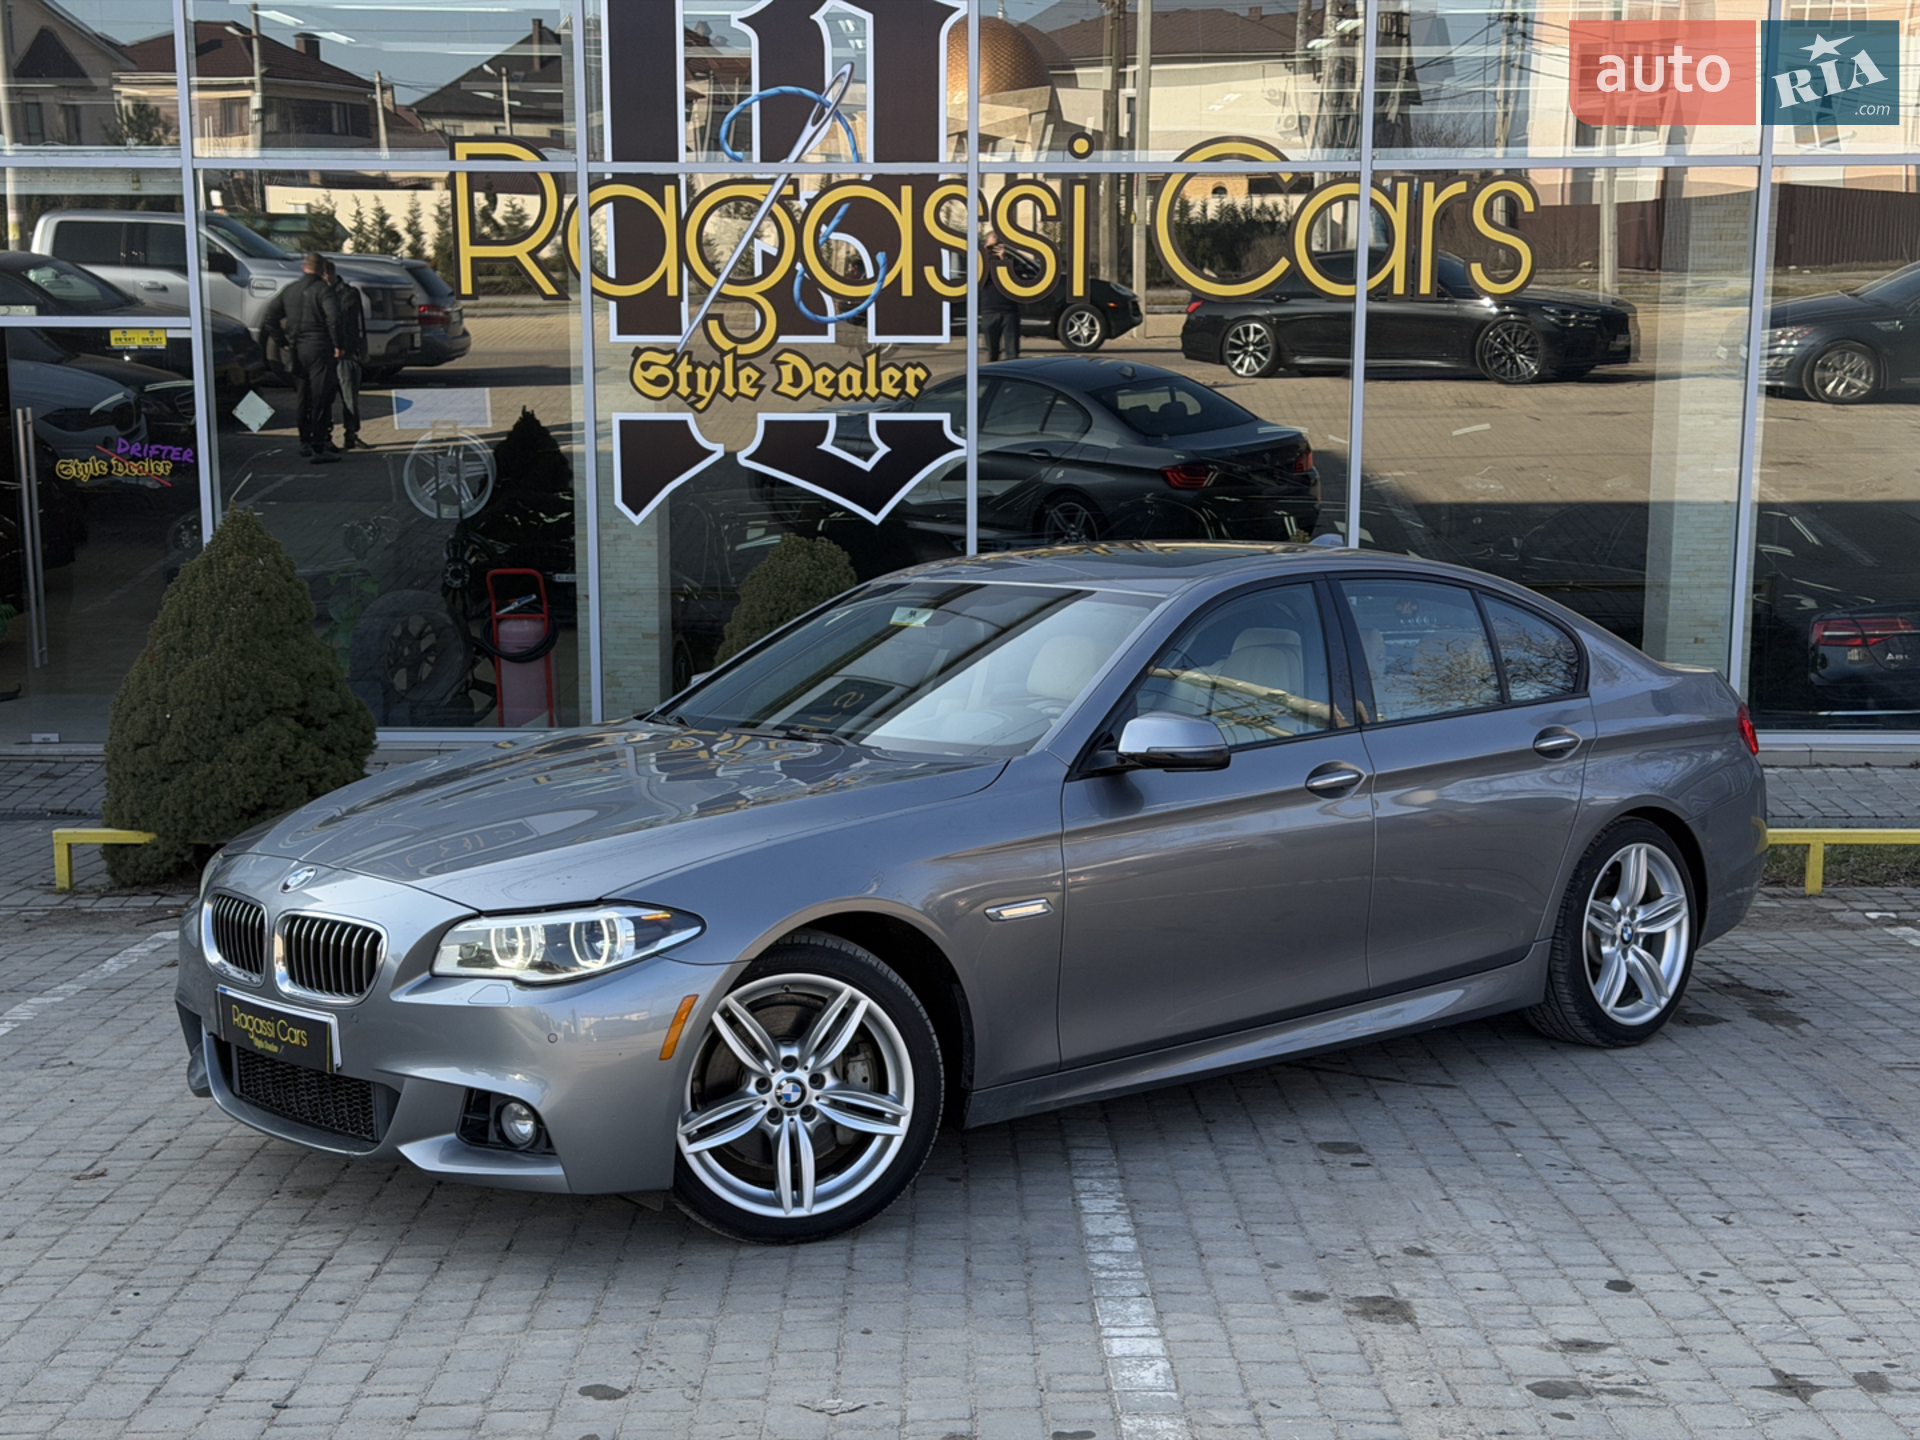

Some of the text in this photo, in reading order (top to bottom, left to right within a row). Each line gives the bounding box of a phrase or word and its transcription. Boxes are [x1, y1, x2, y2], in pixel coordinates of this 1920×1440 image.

[449, 131, 1539, 356] Ragassi Cars
[631, 345, 931, 412] Style Dealer
[56, 456, 173, 482] Style Dealer
[116, 437, 195, 464] DRIFTER
[231, 1004, 308, 1047] Ragassi Cars
